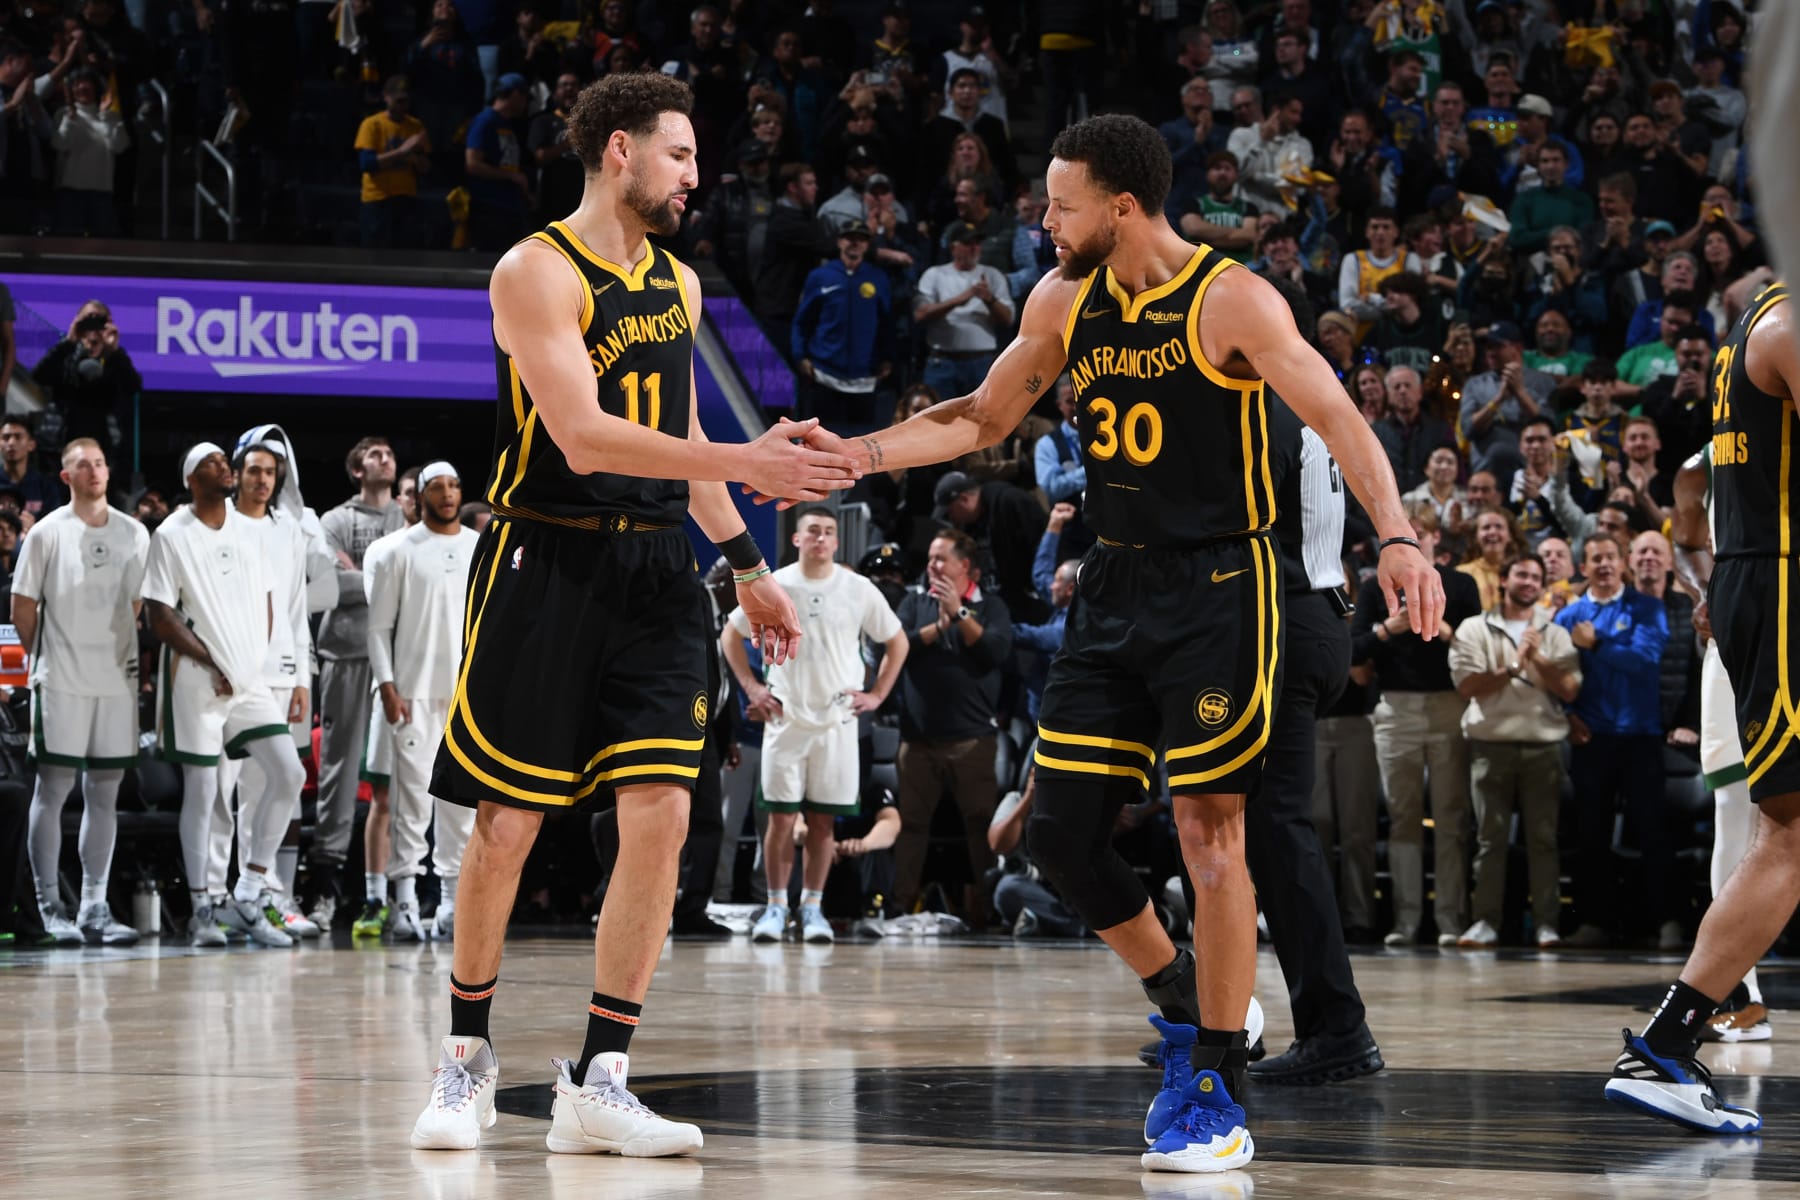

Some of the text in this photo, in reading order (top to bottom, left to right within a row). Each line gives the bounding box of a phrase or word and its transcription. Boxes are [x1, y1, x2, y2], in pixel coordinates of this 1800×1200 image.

[649, 276, 678, 289] Rakuten
[157, 296, 418, 362] Rakuten
[1144, 310, 1184, 322] Rakuten
[588, 329, 625, 378] SAN
[1092, 337, 1187, 379] FRANCISCO
[618, 371, 662, 431] 11
[1086, 397, 1163, 467] 30
[455, 1044, 466, 1058] 11
[615, 1060, 624, 1074] 11
